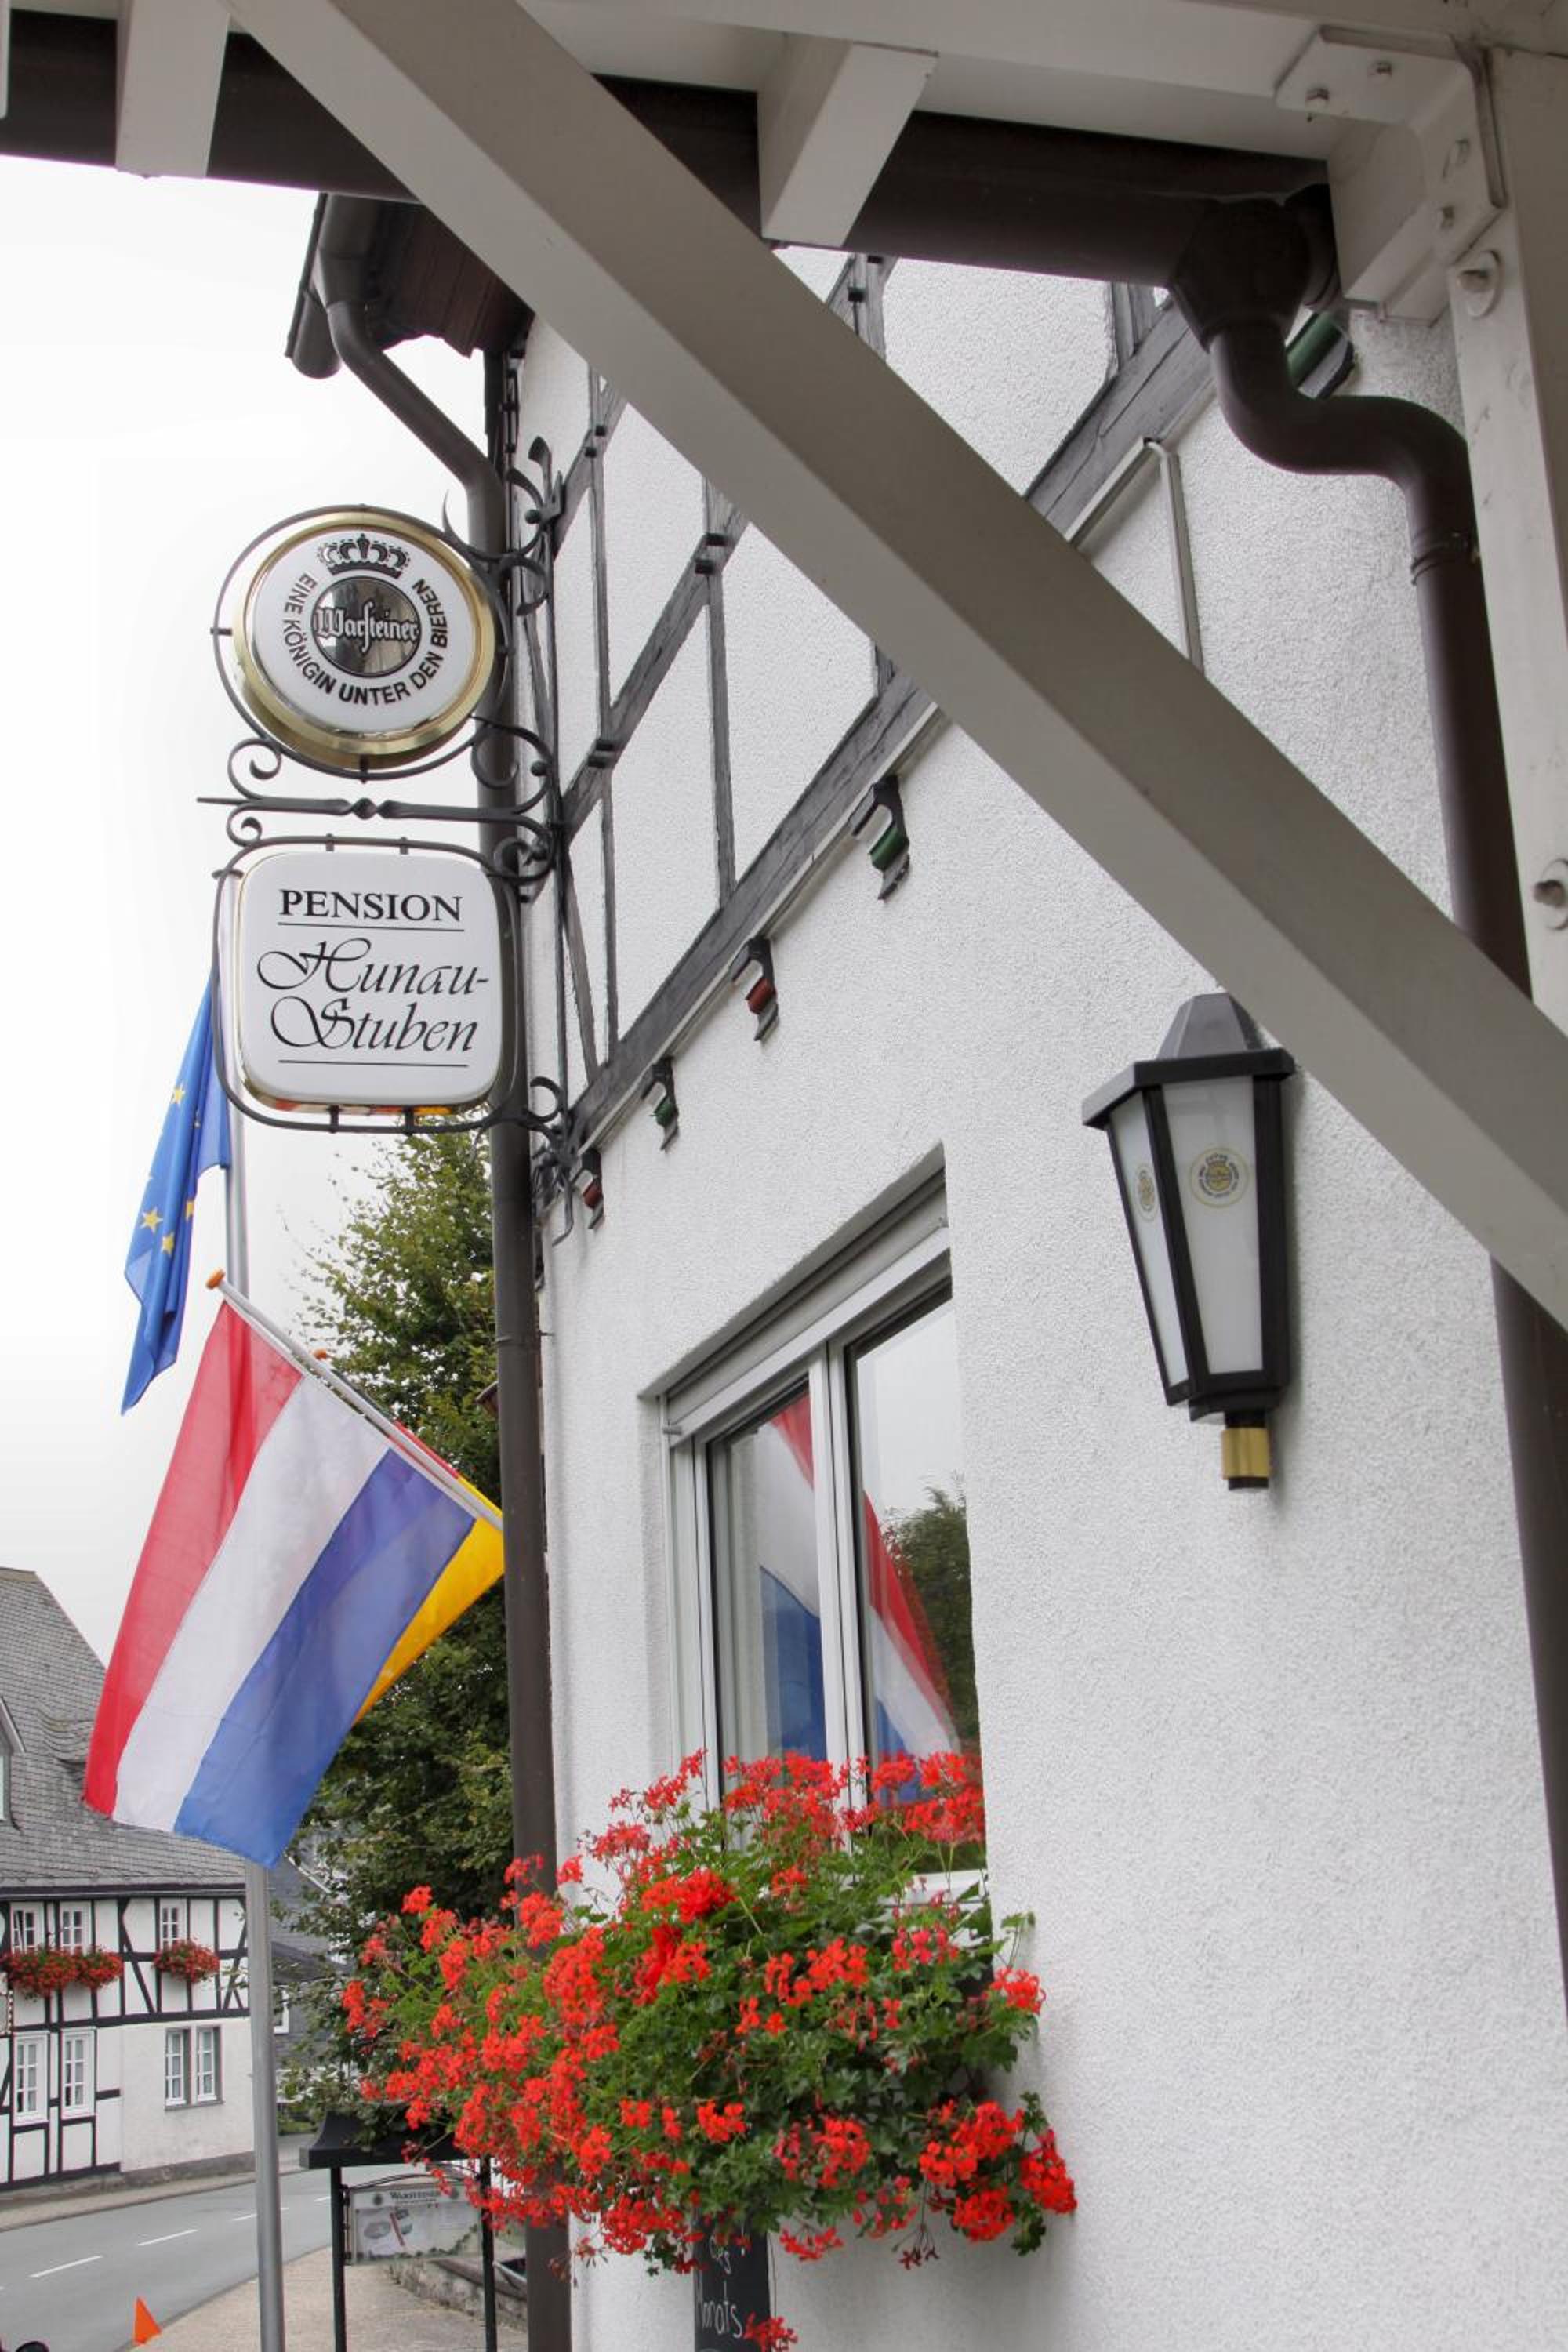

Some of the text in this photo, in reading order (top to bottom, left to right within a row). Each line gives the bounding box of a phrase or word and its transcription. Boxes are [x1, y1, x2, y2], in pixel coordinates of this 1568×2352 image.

[283, 573, 448, 705] EINE KÖNIGIN UNTER DEN BIEREN
[279, 889, 463, 921] PENSION
[257, 938, 490, 995] Hunau-
[271, 996, 478, 1051] Stuben
